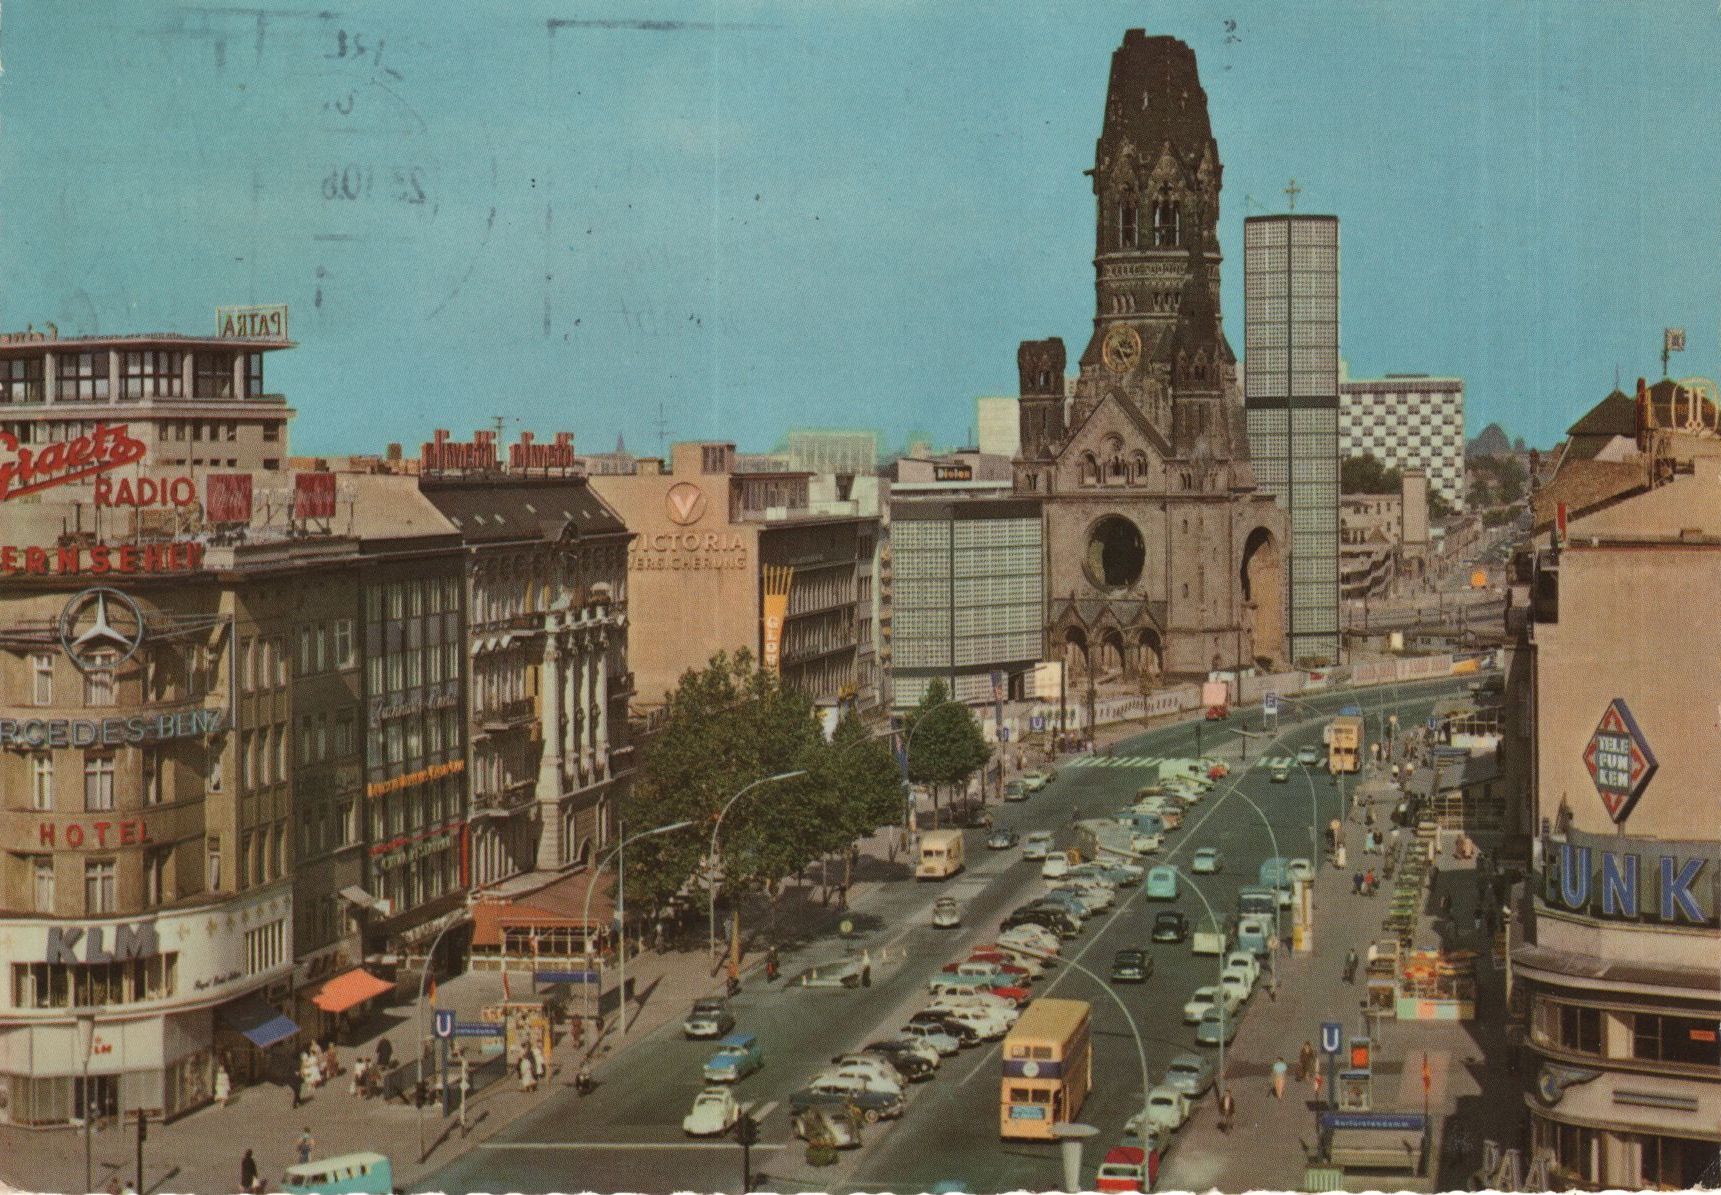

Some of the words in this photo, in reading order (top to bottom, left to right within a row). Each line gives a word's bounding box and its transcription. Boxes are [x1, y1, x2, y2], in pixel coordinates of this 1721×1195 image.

[94, 477, 197, 508] RADIO
[1598, 735, 1629, 753] TELE
[1599, 753, 1629, 771] FUN
[1599, 769, 1629, 788] KEN
[40, 819, 149, 846] HOTEL
[47, 923, 159, 964] KLM
[436, 1013, 451, 1037] U
[1323, 1025, 1340, 1053] U
